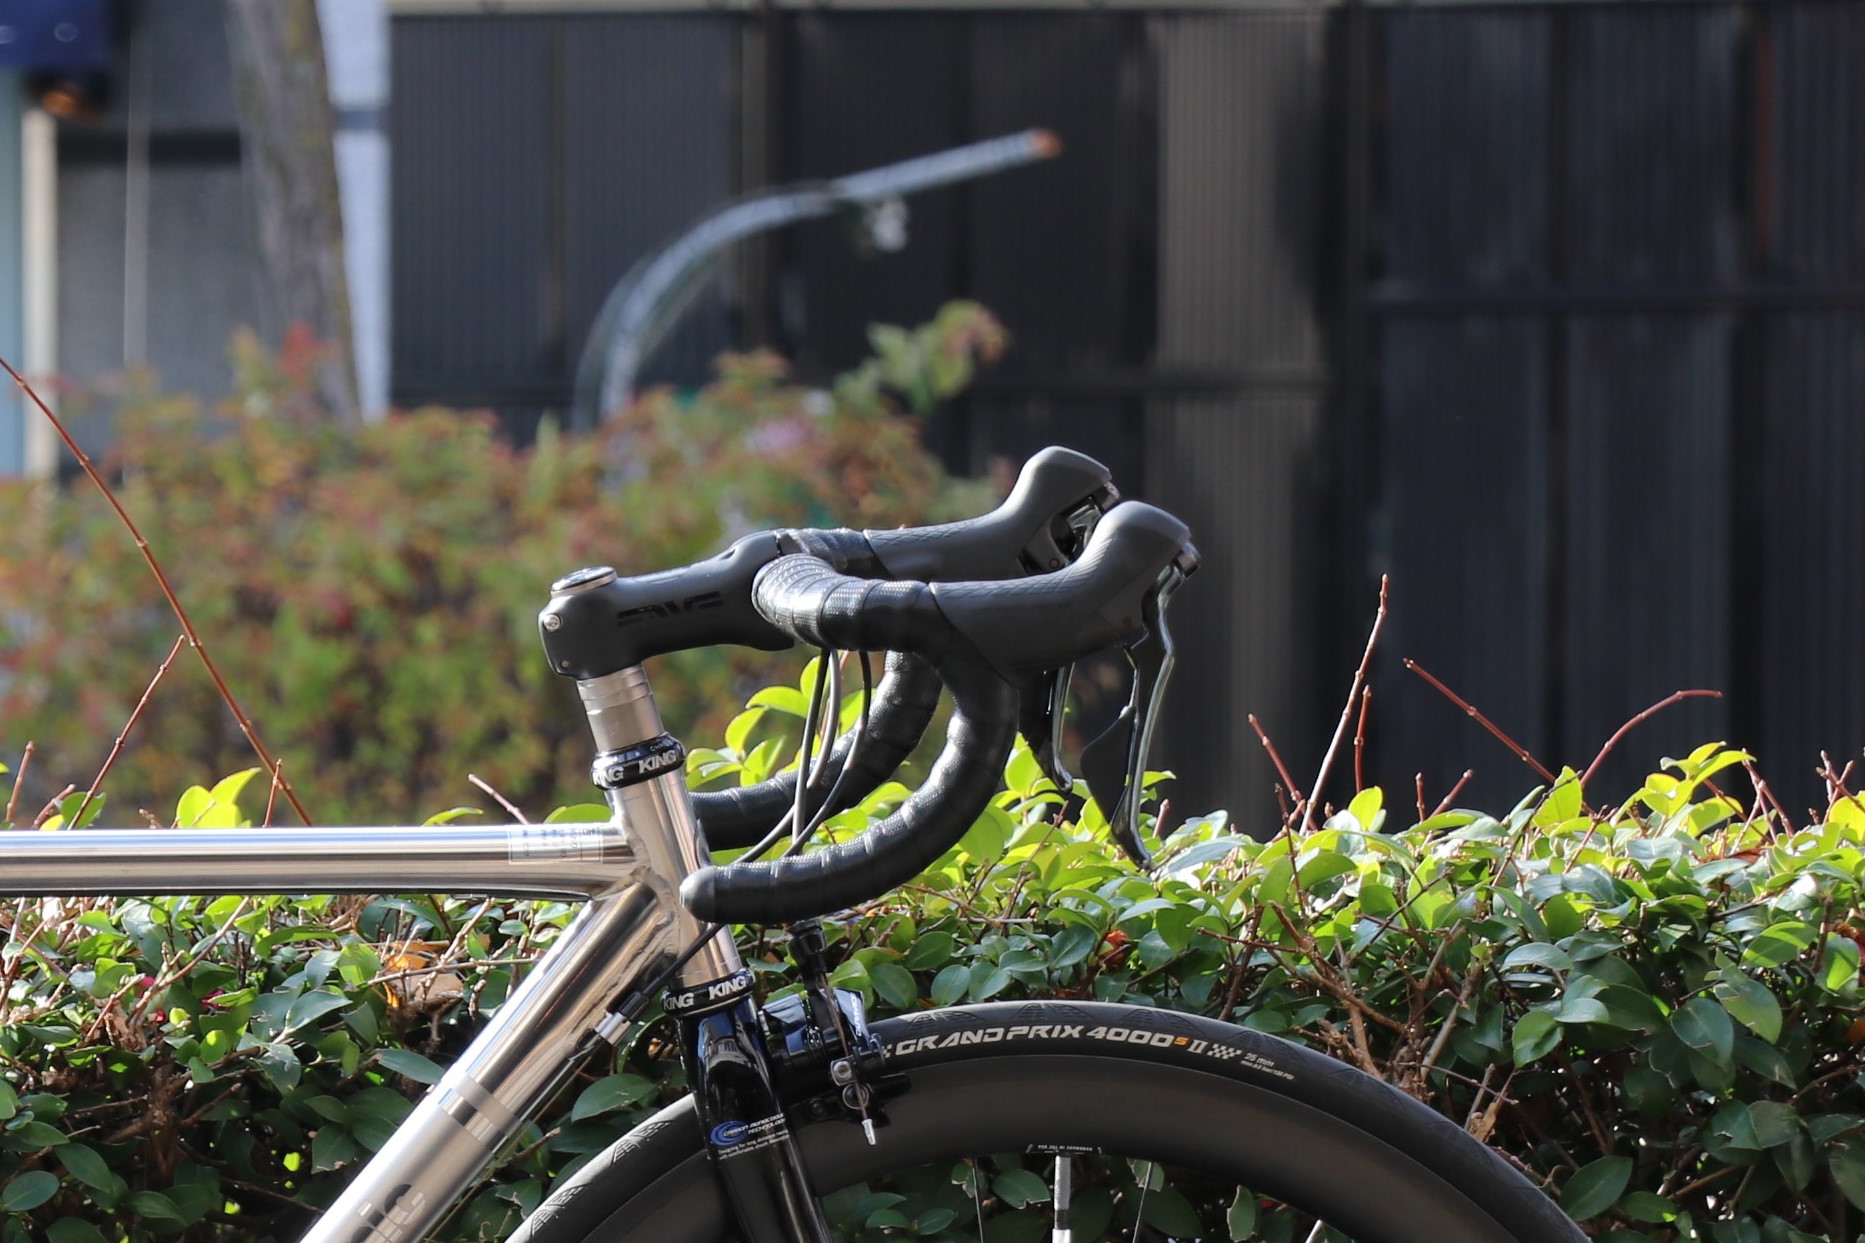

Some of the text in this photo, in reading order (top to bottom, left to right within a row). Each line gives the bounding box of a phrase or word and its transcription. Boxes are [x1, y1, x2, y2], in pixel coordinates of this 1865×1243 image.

[639, 749, 677, 774] KING
[708, 975, 747, 1000] KING
[663, 992, 694, 1011] KING
[894, 1028, 1005, 1056] GRAND
[1007, 1024, 1085, 1041] PRIX
[1244, 1053, 1275, 1067] 25 mm
